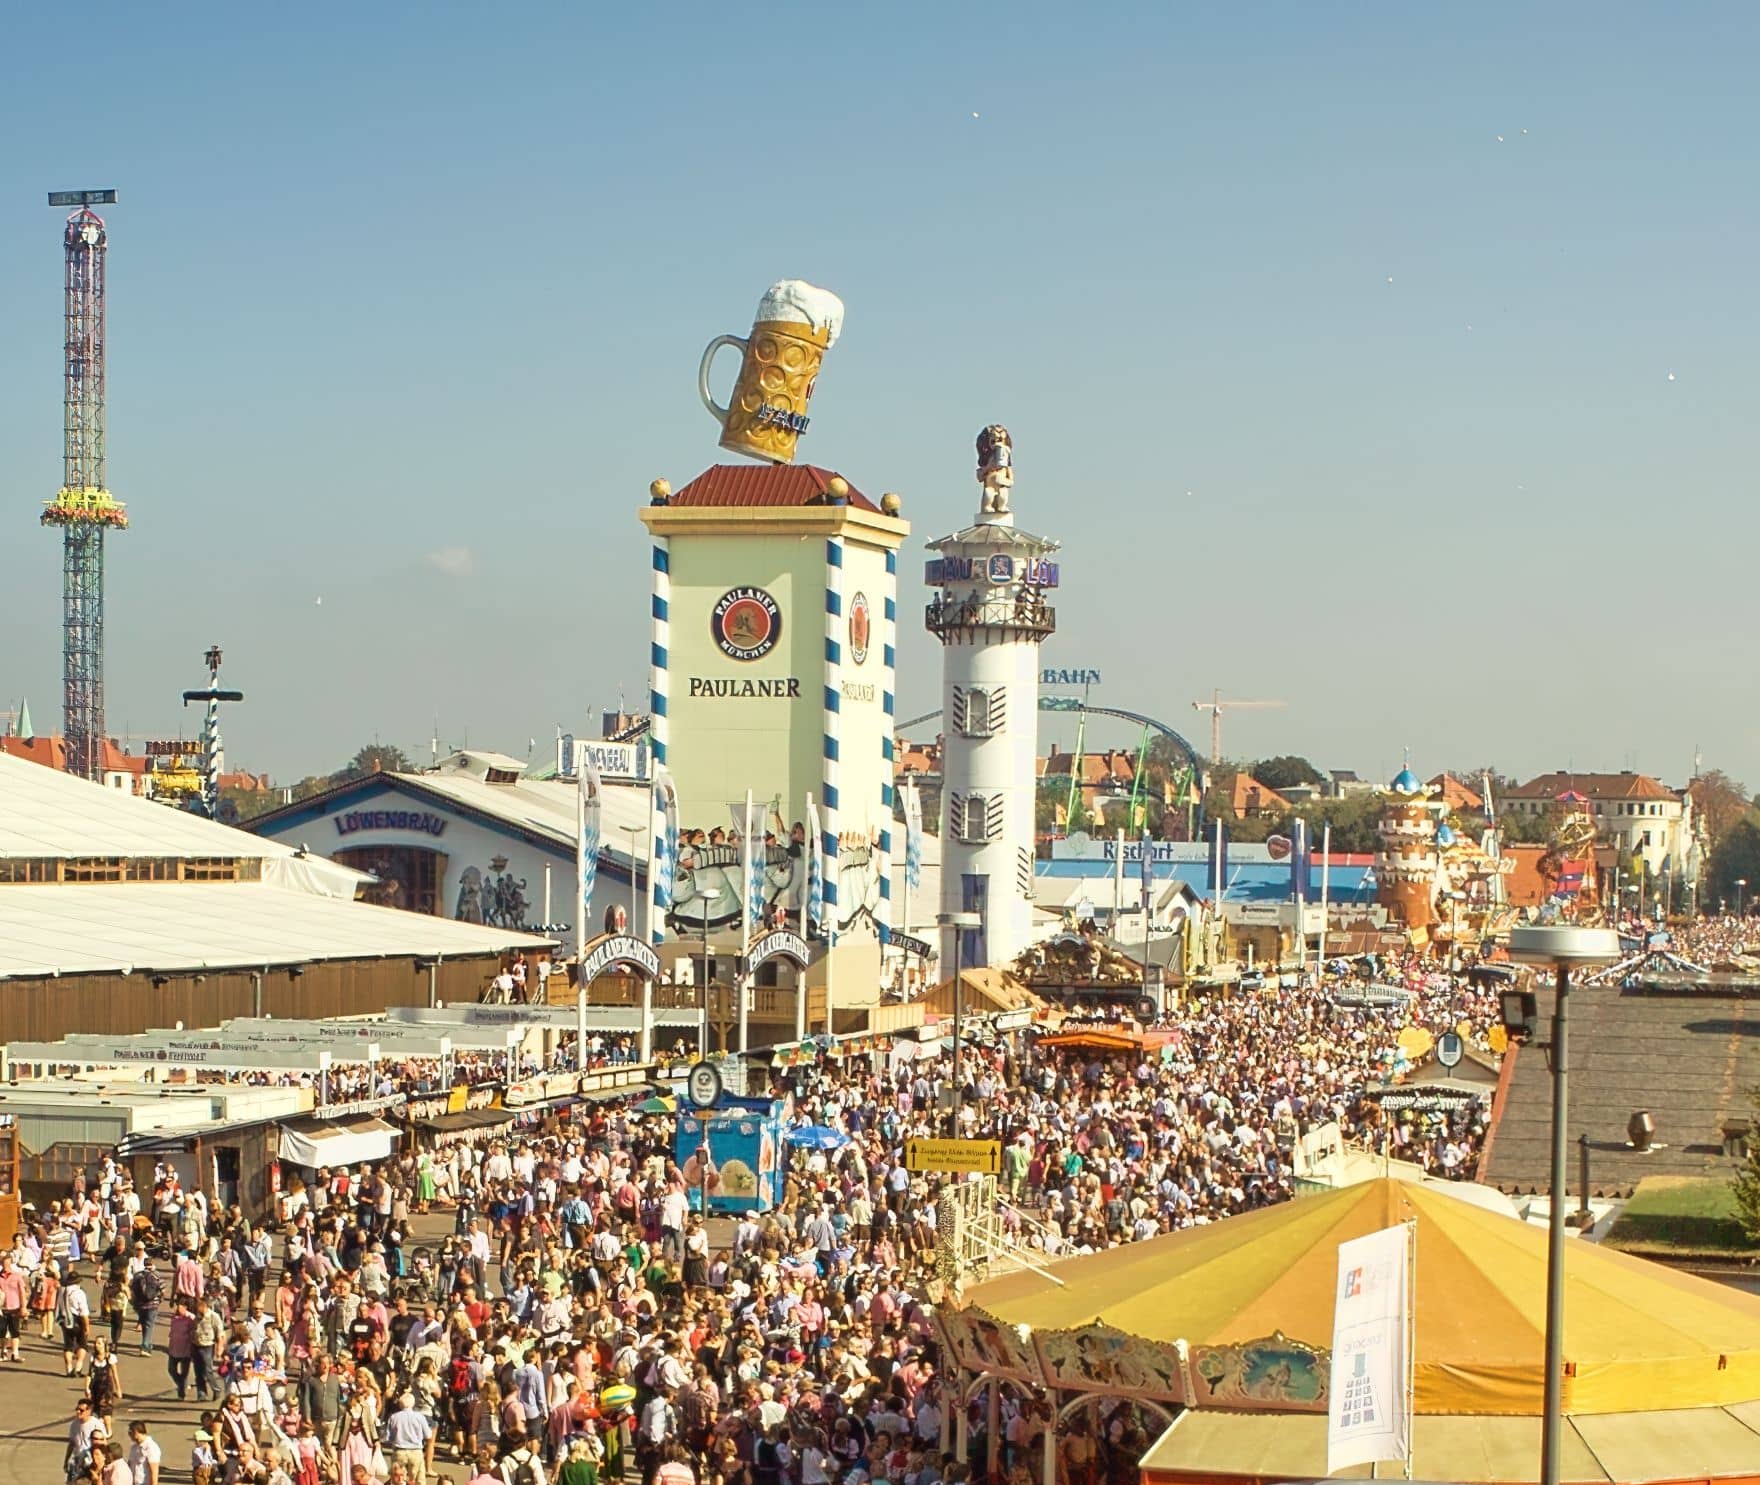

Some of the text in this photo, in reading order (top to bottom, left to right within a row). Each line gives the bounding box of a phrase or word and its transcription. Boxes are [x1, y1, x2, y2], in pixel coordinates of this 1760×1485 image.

[715, 588, 778, 617] PAULANER
[688, 677, 801, 698] PAULANER
[334, 810, 448, 837] LÖWENBRÄU
